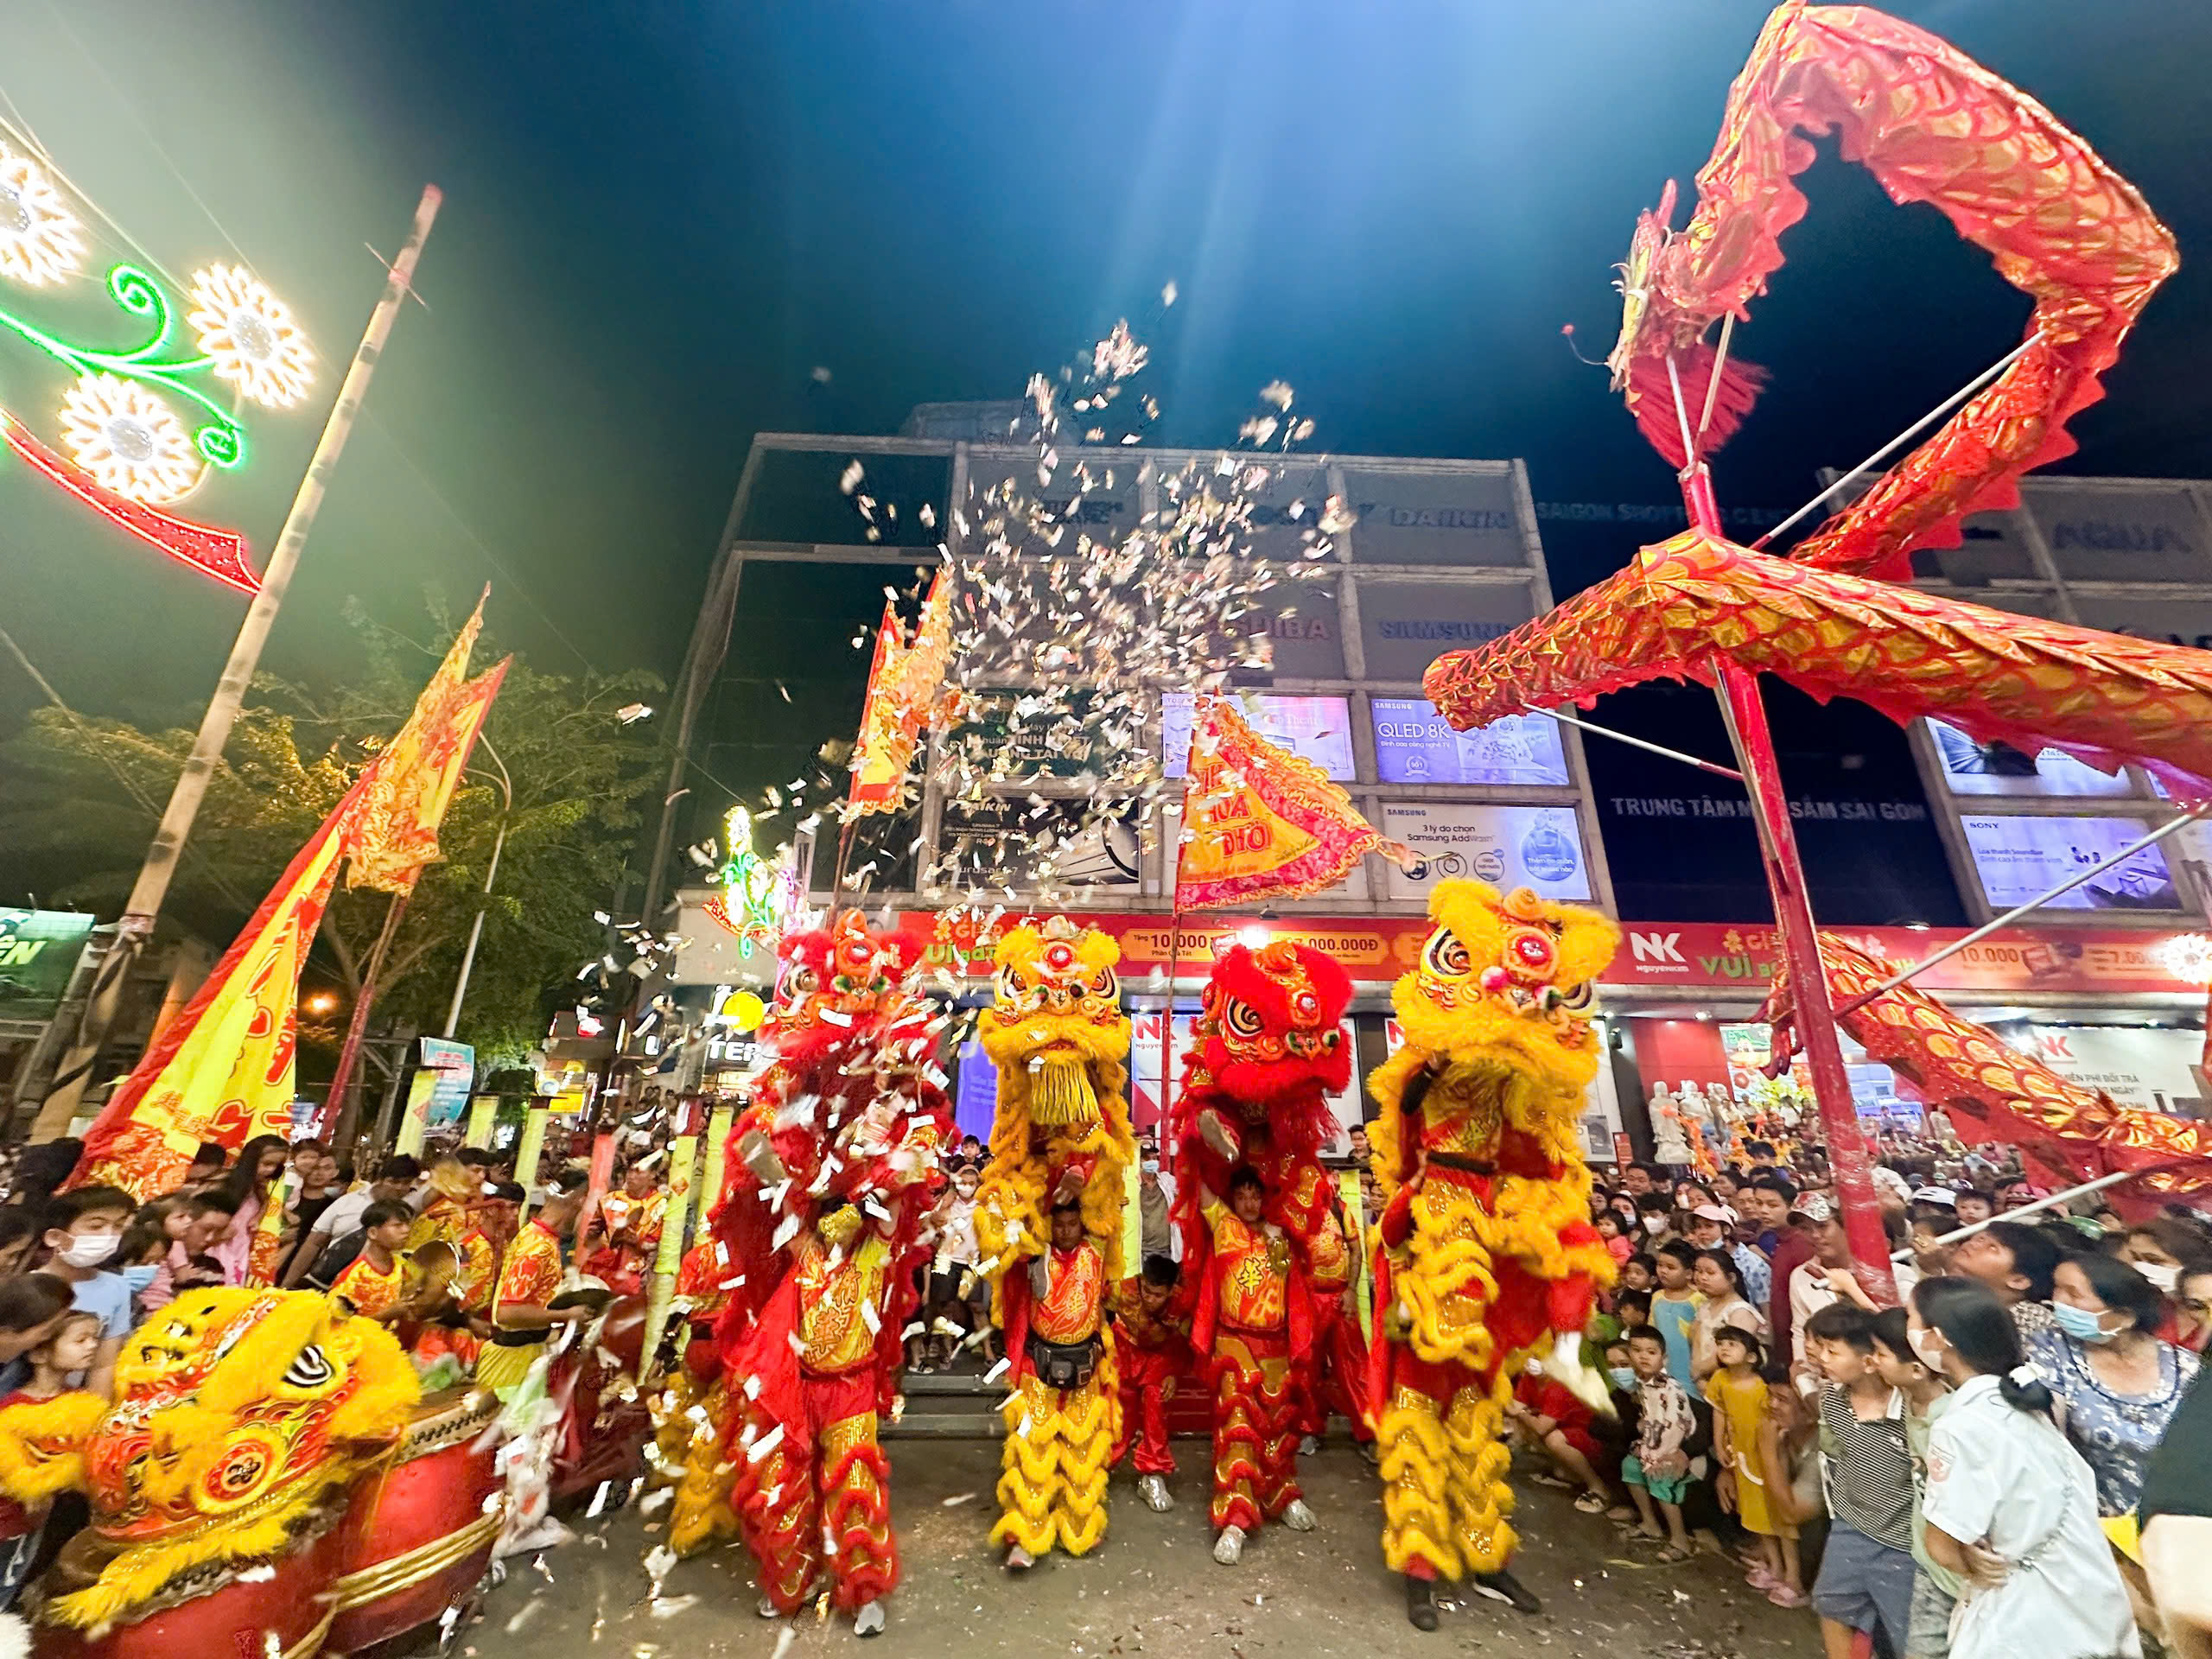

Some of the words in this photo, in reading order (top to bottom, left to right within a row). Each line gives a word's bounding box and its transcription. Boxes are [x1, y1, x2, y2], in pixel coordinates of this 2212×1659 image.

[1375, 702, 1413, 710] SAMSUNG
[1377, 722, 1425, 739] QLED
[1427, 723, 1451, 739] 8K
[959, 802, 1012, 812] AIKIN
[1611, 798, 1686, 817] TRUNG
[1687, 794, 1736, 817] TÂM
[1407, 834, 1450, 844] Samsung
[1150, 934, 1207, 949] 10000
[1630, 932, 1687, 963] NK
